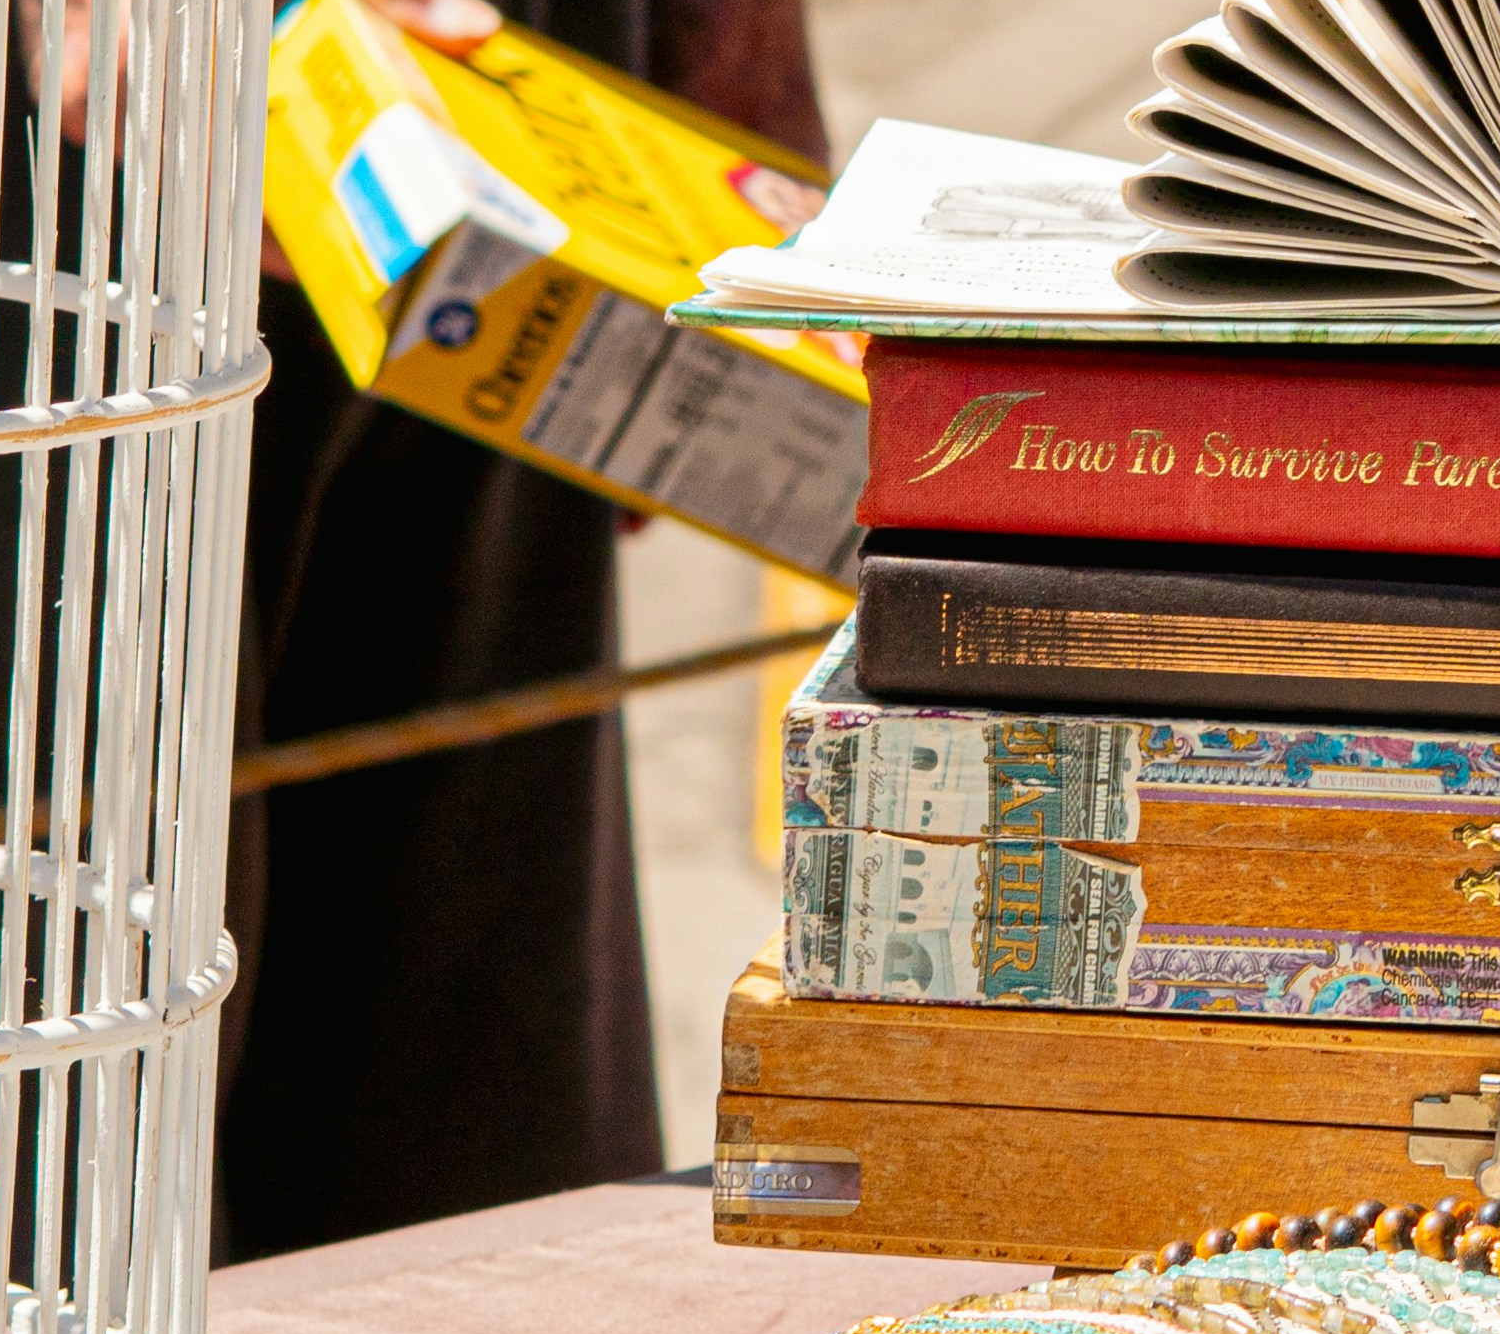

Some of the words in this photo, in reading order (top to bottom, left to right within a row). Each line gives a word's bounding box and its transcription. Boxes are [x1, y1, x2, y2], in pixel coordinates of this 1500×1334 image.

[1010, 422, 1119, 473] How
[1126, 427, 1177, 476] To
[1195, 430, 1384, 487] Survive
[1317, 775, 1337, 786] MY
[1339, 776, 1387, 788] FATHER
[1390, 777, 1436, 789] CIGARS
[826, 782, 851, 904] NICRAGUA
[858, 852, 884, 900] Cigar
[1086, 878, 1102, 917] SEAL
[1084, 919, 1100, 950] FOR
[1381, 948, 1465, 969] WARNING:
[1381, 968, 1452, 989] Chemicals
[1436, 992, 1463, 1008] And
